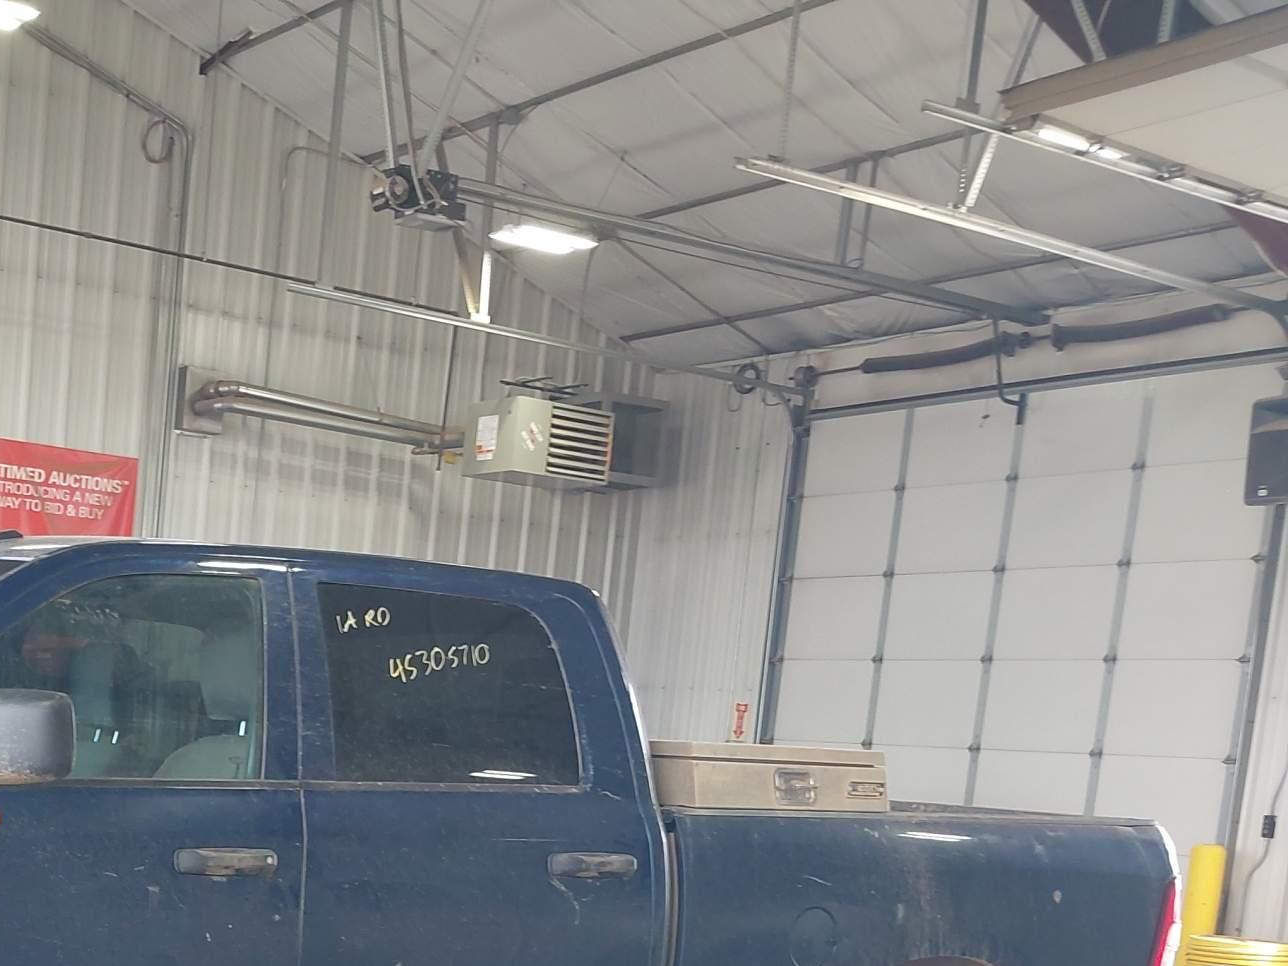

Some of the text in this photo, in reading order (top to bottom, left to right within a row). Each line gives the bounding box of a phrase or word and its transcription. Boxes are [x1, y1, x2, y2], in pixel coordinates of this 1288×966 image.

[23, 498, 42, 512] TO
[42, 501, 64, 515] BID
[66, 505, 76, 516] &
[78, 506, 105, 520] BUY
[72, 492, 83, 503] A
[84, 493, 112, 507] NEW
[389, 643, 490, 683] 45305710
